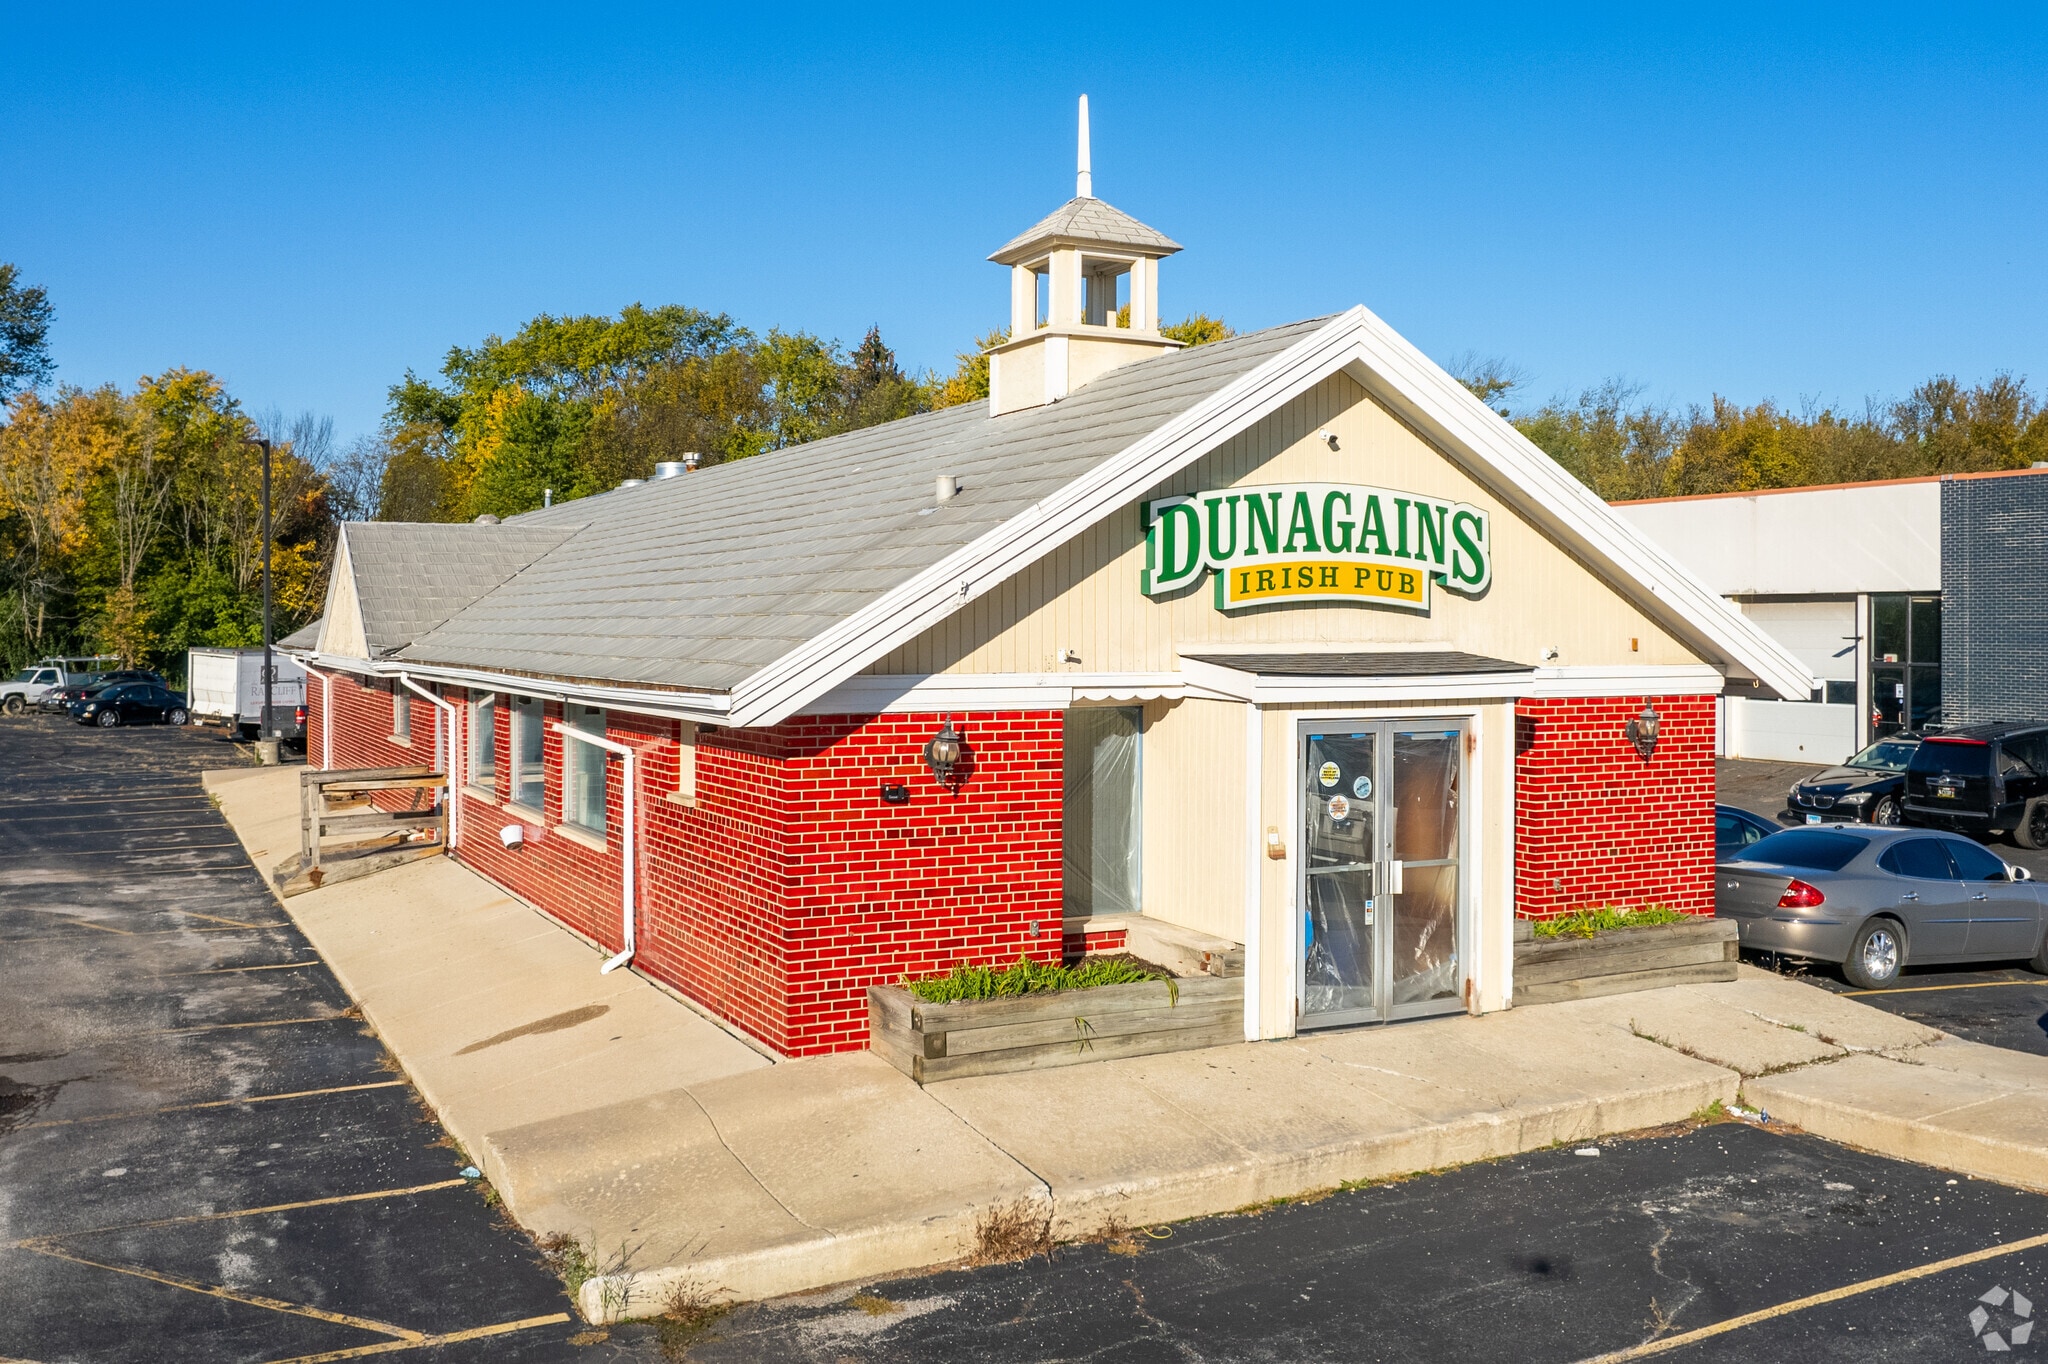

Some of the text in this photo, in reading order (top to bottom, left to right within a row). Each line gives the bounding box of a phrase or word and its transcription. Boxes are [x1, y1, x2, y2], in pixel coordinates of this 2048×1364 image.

[1157, 491, 1485, 584] DUNAGAINS
[1240, 566, 1415, 594] IRISH PUB
[251, 686, 296, 697] RACLIFF
